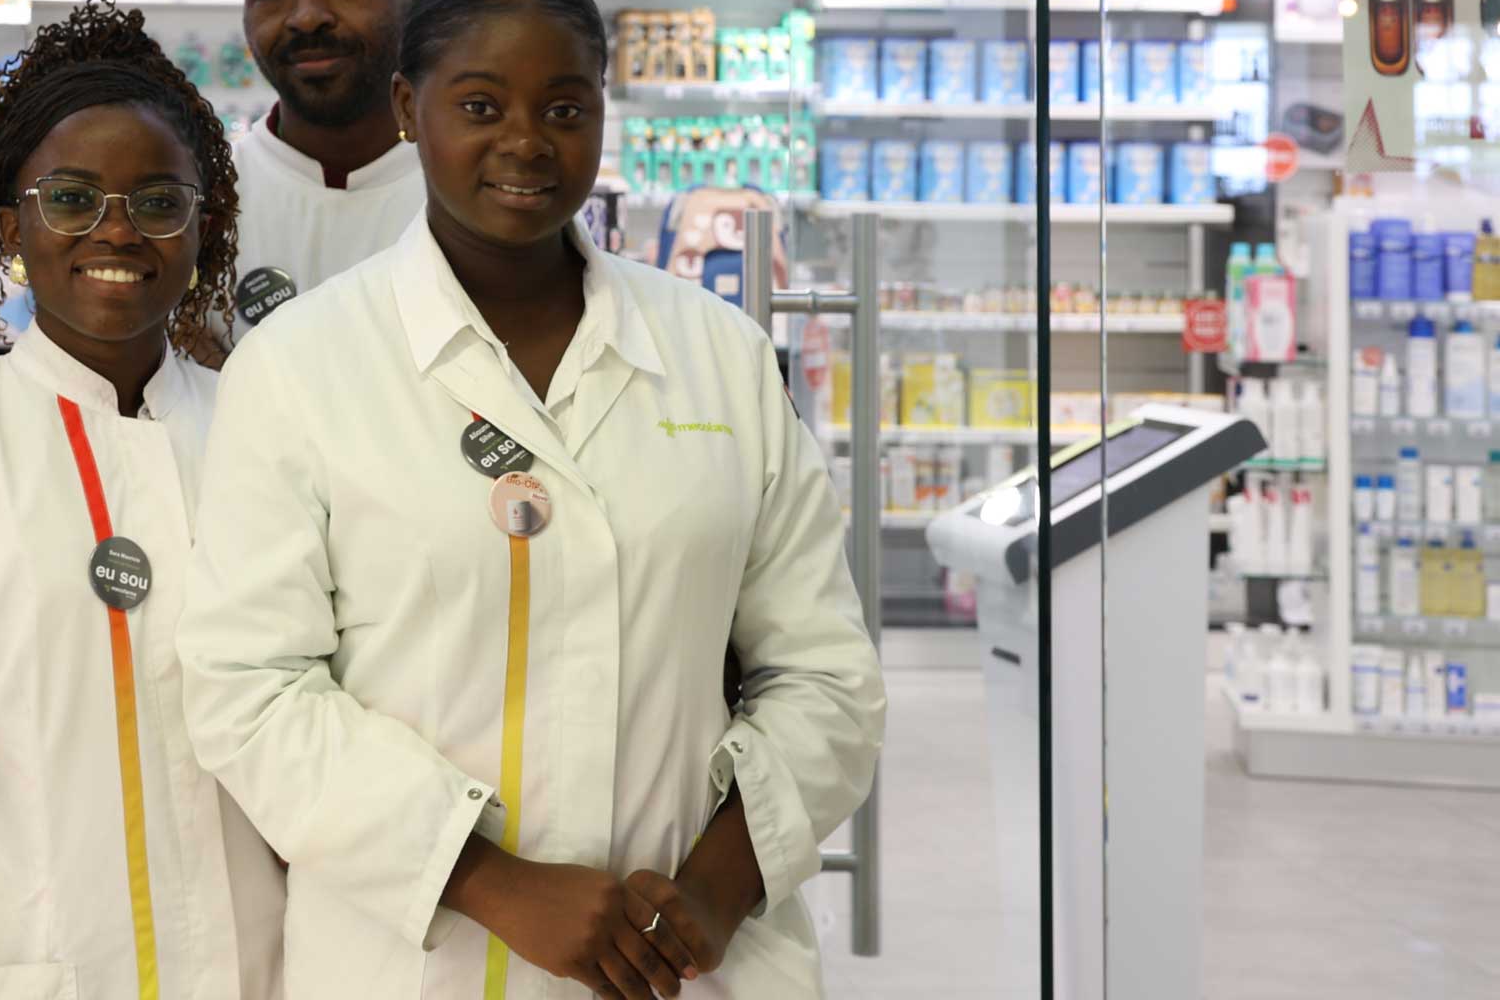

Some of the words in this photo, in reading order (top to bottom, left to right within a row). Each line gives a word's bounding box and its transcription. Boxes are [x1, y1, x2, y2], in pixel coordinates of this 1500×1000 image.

[245, 302, 264, 318] eu
[265, 286, 292, 307] sou
[480, 451, 501, 468] eu
[95, 565, 116, 581] eu
[119, 571, 149, 590] sou
